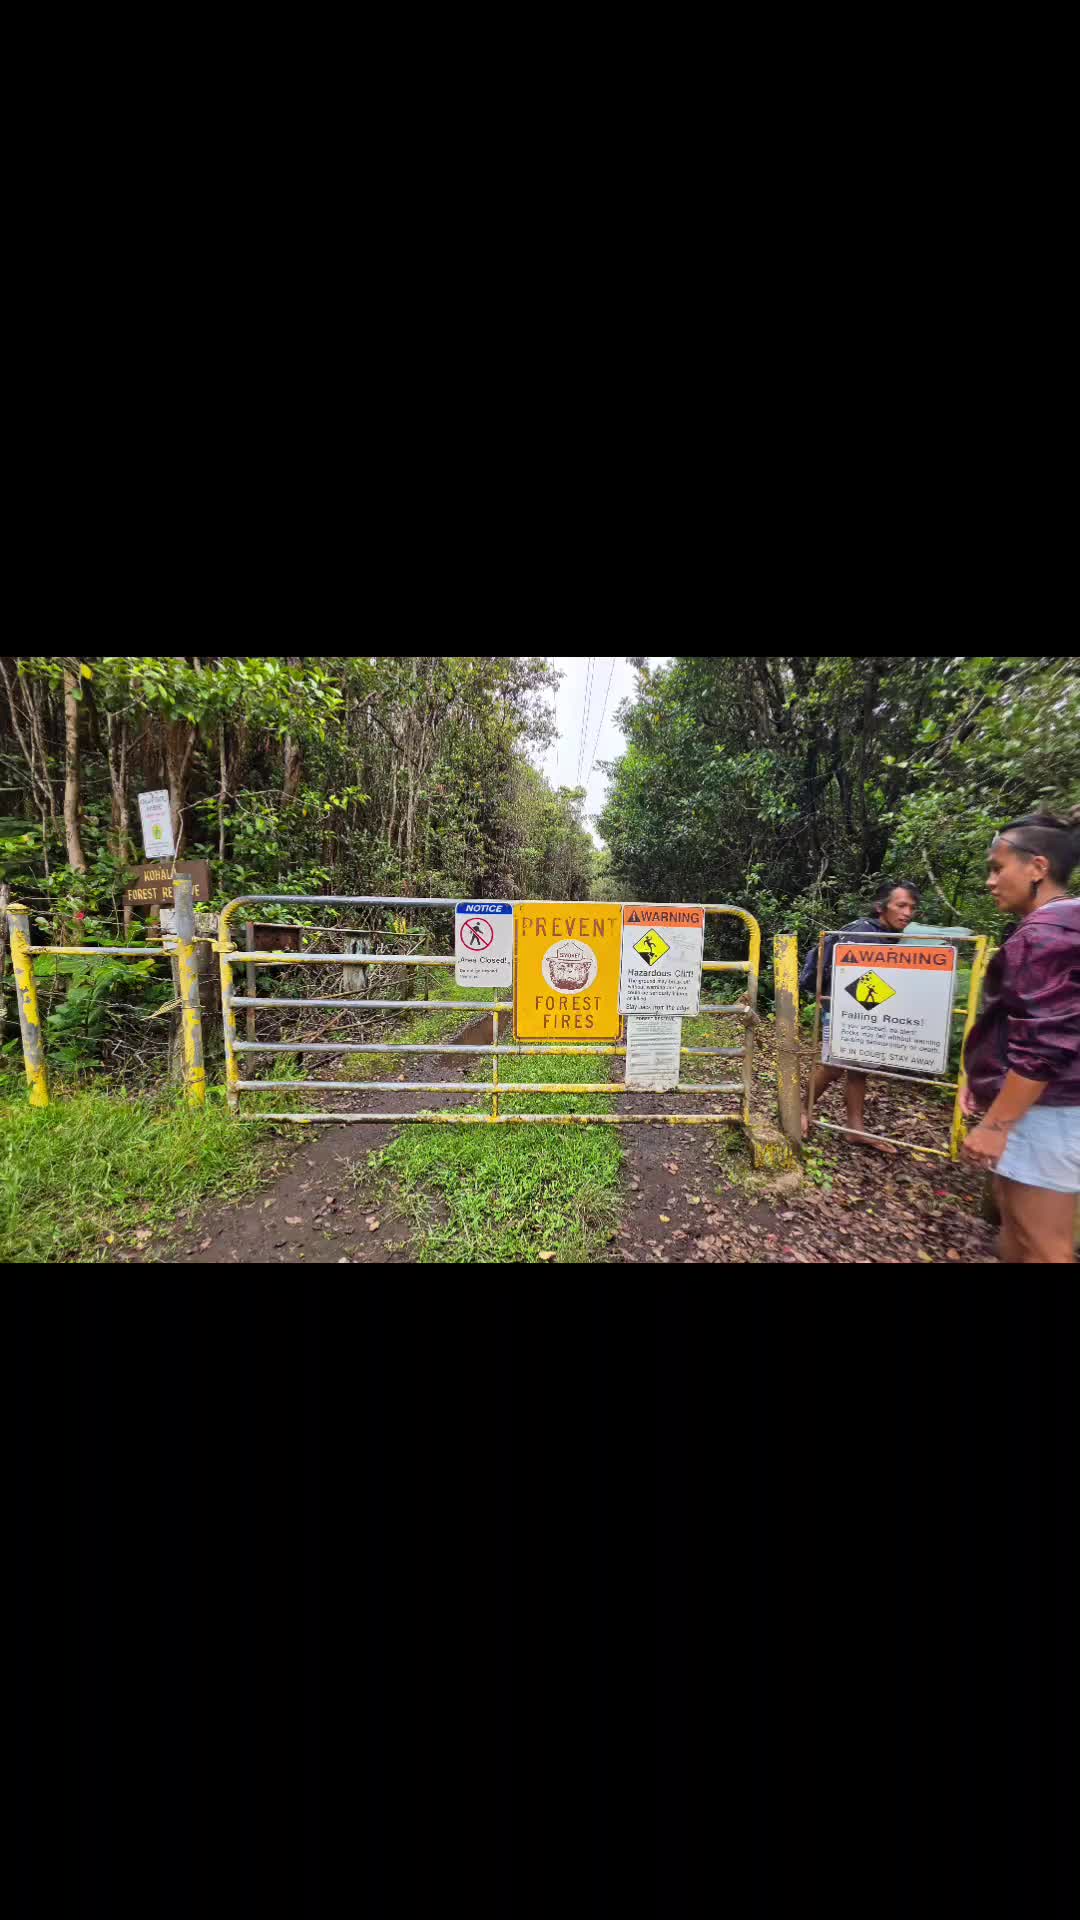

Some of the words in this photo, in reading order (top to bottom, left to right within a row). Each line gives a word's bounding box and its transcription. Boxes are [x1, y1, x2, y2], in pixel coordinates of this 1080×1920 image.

[128, 888, 158, 900] FOREST
[466, 904, 503, 912] NOTICE
[641, 910, 699, 923] WARNING
[522, 917, 617, 936] PREVENT
[860, 950, 947, 966] WARNING
[535, 996, 601, 1010] FOREST
[544, 1014, 594, 1028] FIRES
[841, 1010, 877, 1023] Falling
[883, 1015, 924, 1026] Rocks!
[890, 1054, 908, 1062] STAY
